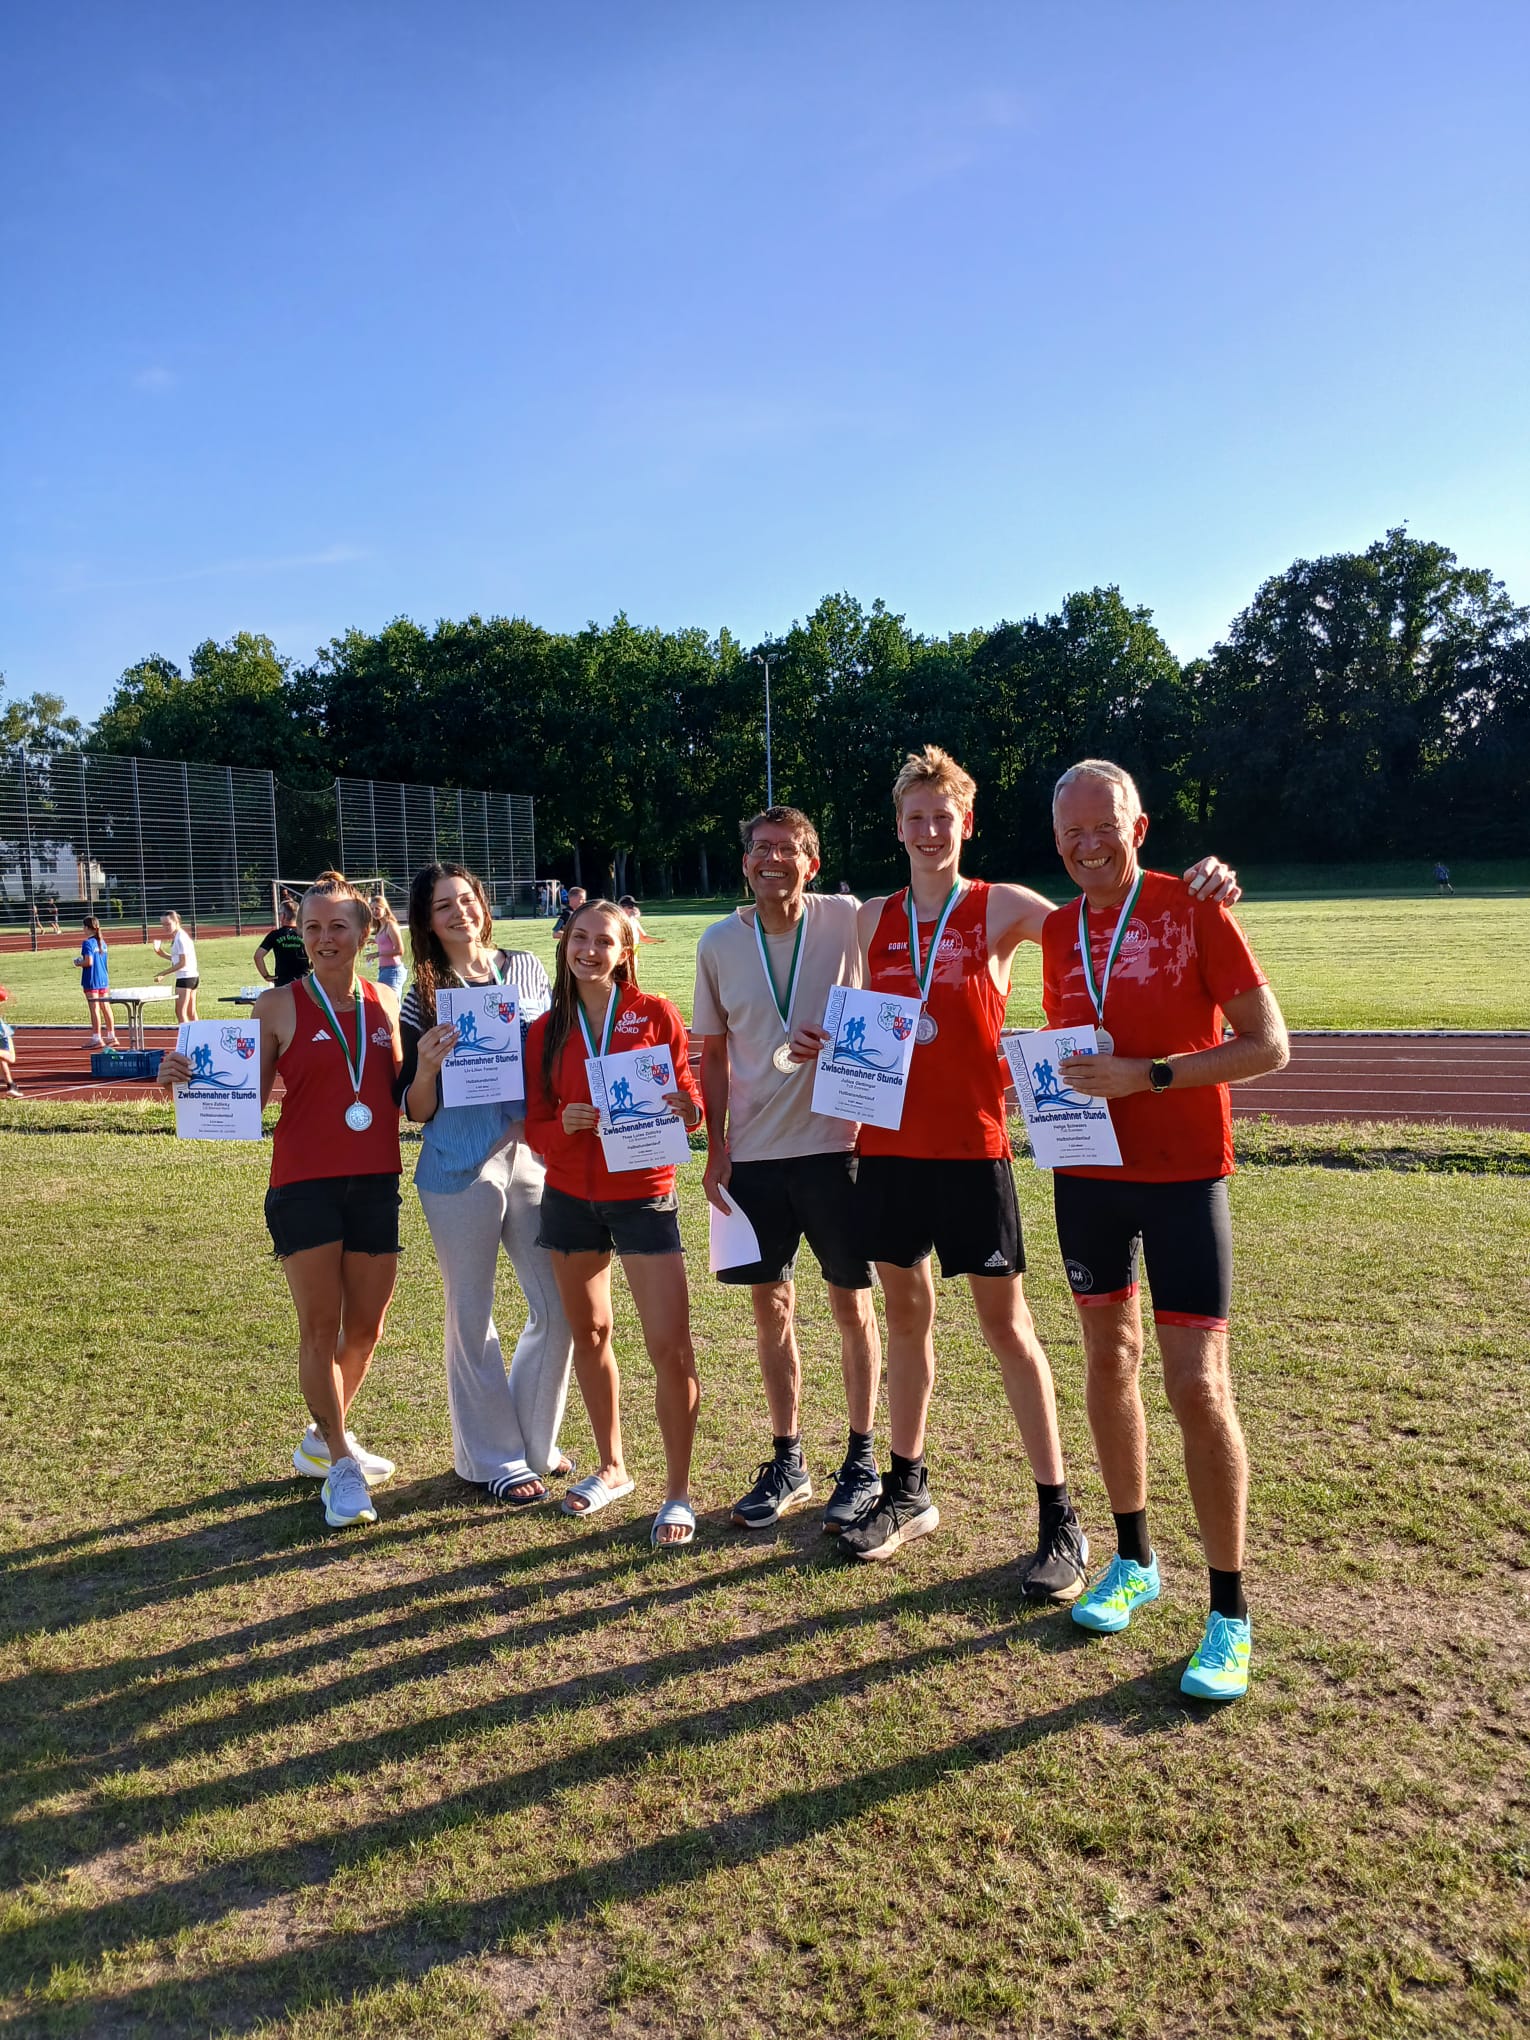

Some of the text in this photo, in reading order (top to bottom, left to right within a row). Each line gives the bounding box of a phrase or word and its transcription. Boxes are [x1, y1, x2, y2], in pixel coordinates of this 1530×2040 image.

[888, 941, 908, 950] GOBIK
[614, 1025, 639, 1034] NORD
[445, 1054, 519, 1068] Zwischenahner Stunde
[821, 1061, 903, 1086] Zwischenahner Stunde
[1006, 1041, 1037, 1114] URKUNDE
[178, 1090, 257, 1100] Zwischenahner Stunde
[1029, 1111, 1107, 1124] Zwischenahner Stunde
[603, 1115, 680, 1136] Zwischenahner Stunde
